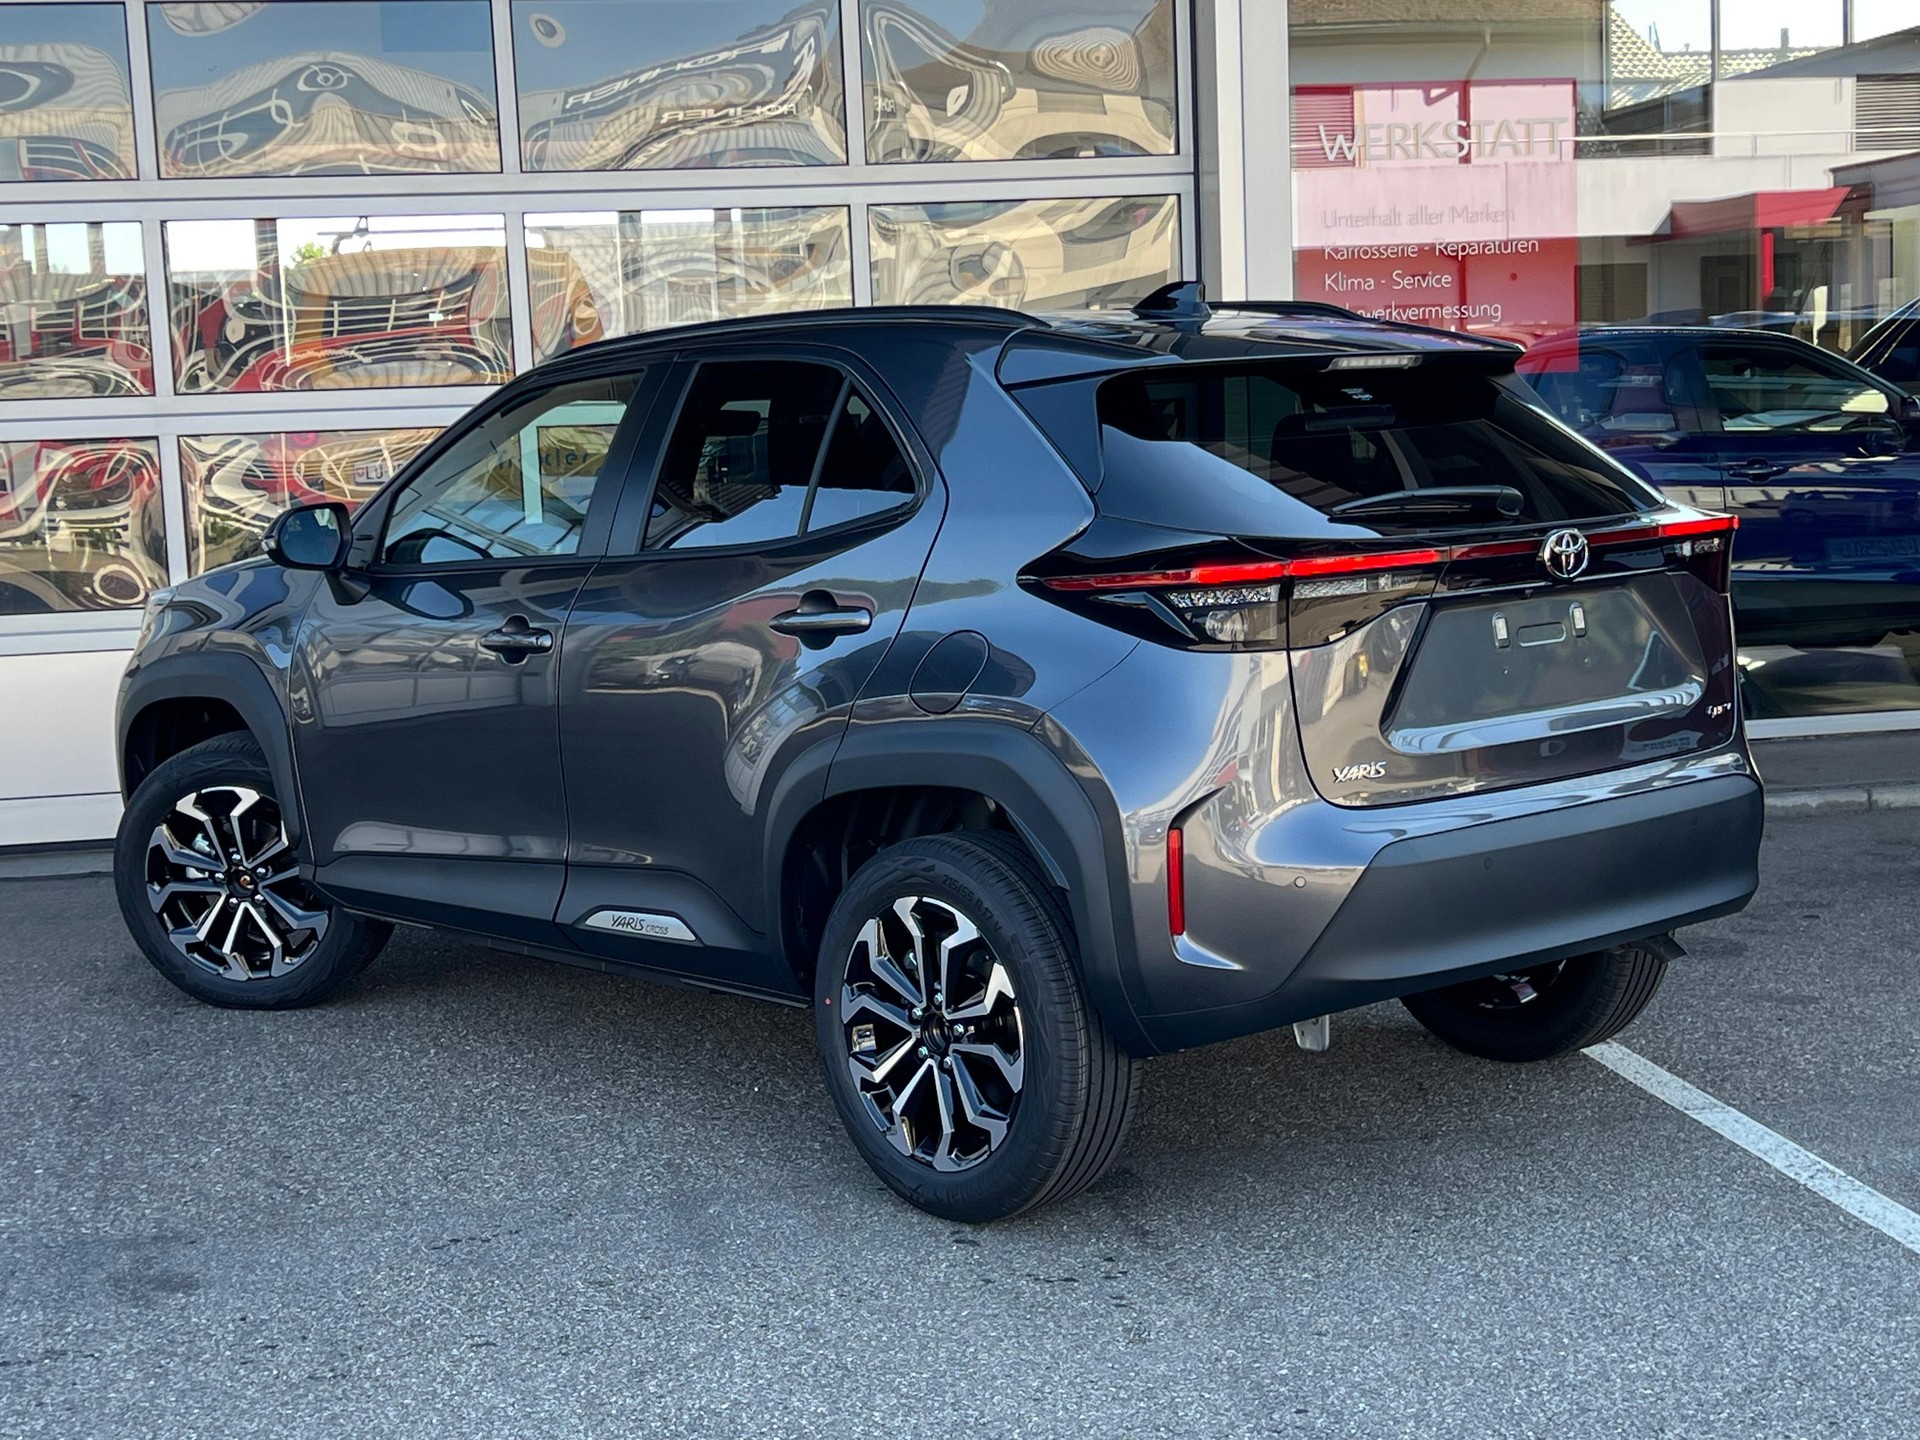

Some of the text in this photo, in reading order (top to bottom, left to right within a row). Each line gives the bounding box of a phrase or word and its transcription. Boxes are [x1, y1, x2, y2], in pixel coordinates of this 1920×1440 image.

[1318, 117, 1568, 161] WERKSTATT
[1323, 203, 1515, 228] Unterhalt aller Marken
[1324, 243, 1418, 261] Karrosserie
[1434, 238, 1539, 261] Reparaturen
[1324, 273, 1375, 291] Klima
[1391, 270, 1452, 290] Service
[1332, 762, 1387, 783] YARIS
[611, 914, 669, 935] YARIS CROSS
